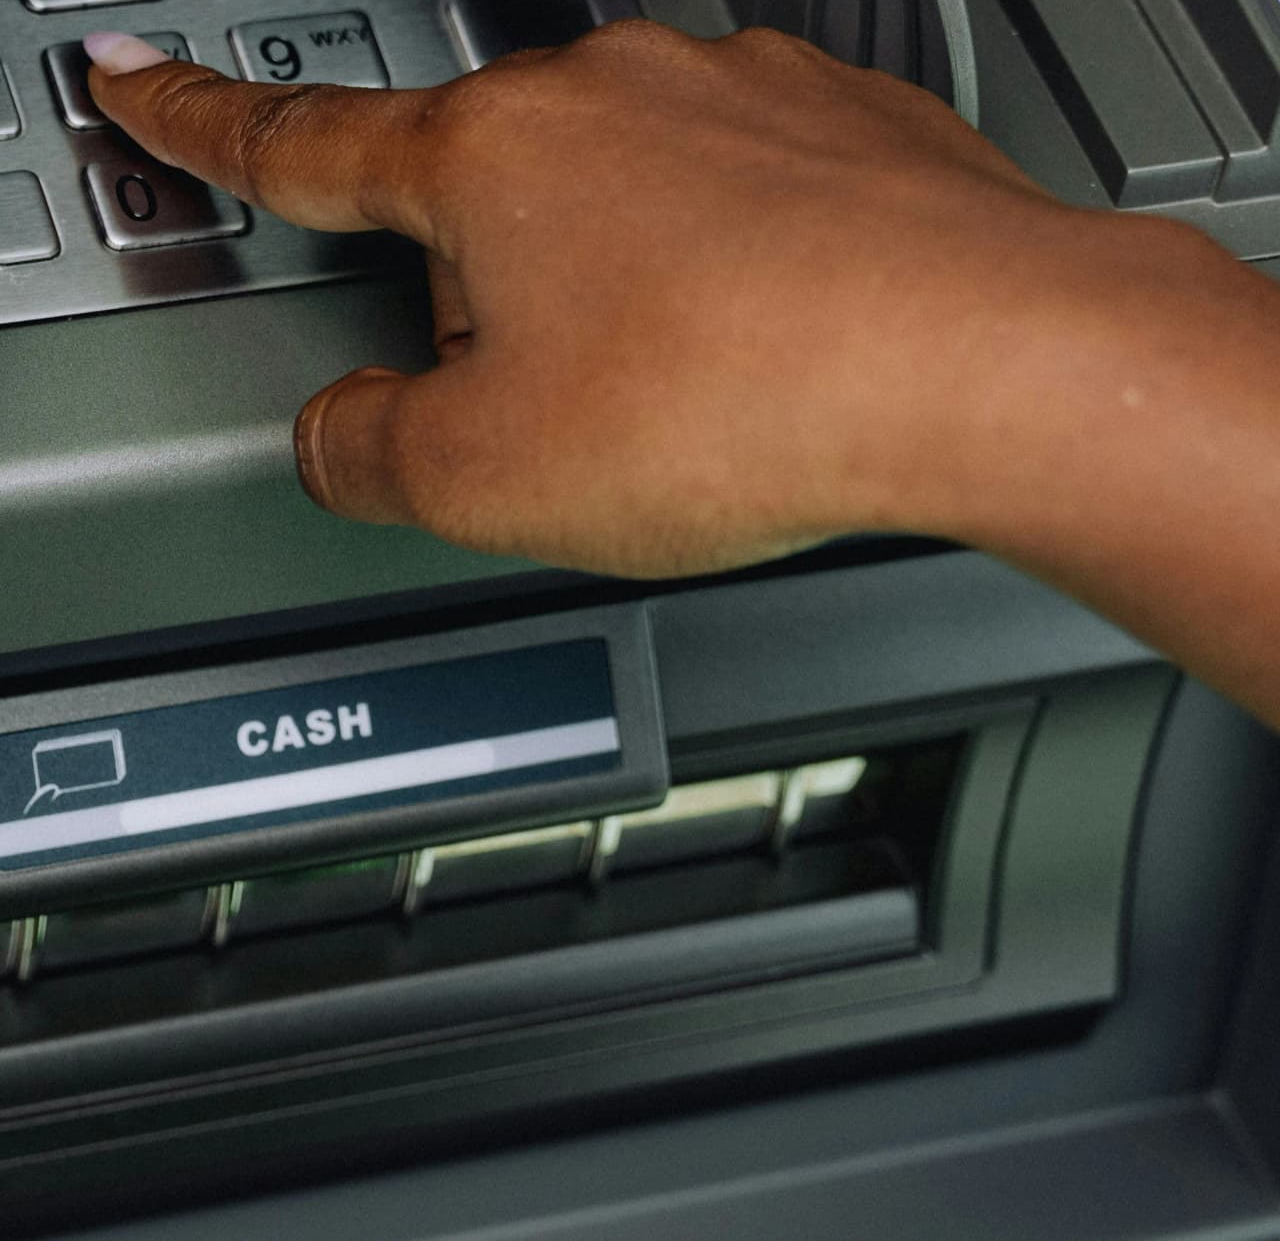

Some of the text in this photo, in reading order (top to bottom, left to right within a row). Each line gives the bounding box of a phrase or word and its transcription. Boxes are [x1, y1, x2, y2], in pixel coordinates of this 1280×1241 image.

[259, 35, 303, 82] 9
[113, 173, 159, 223] 0
[235, 702, 375, 757] CASH
